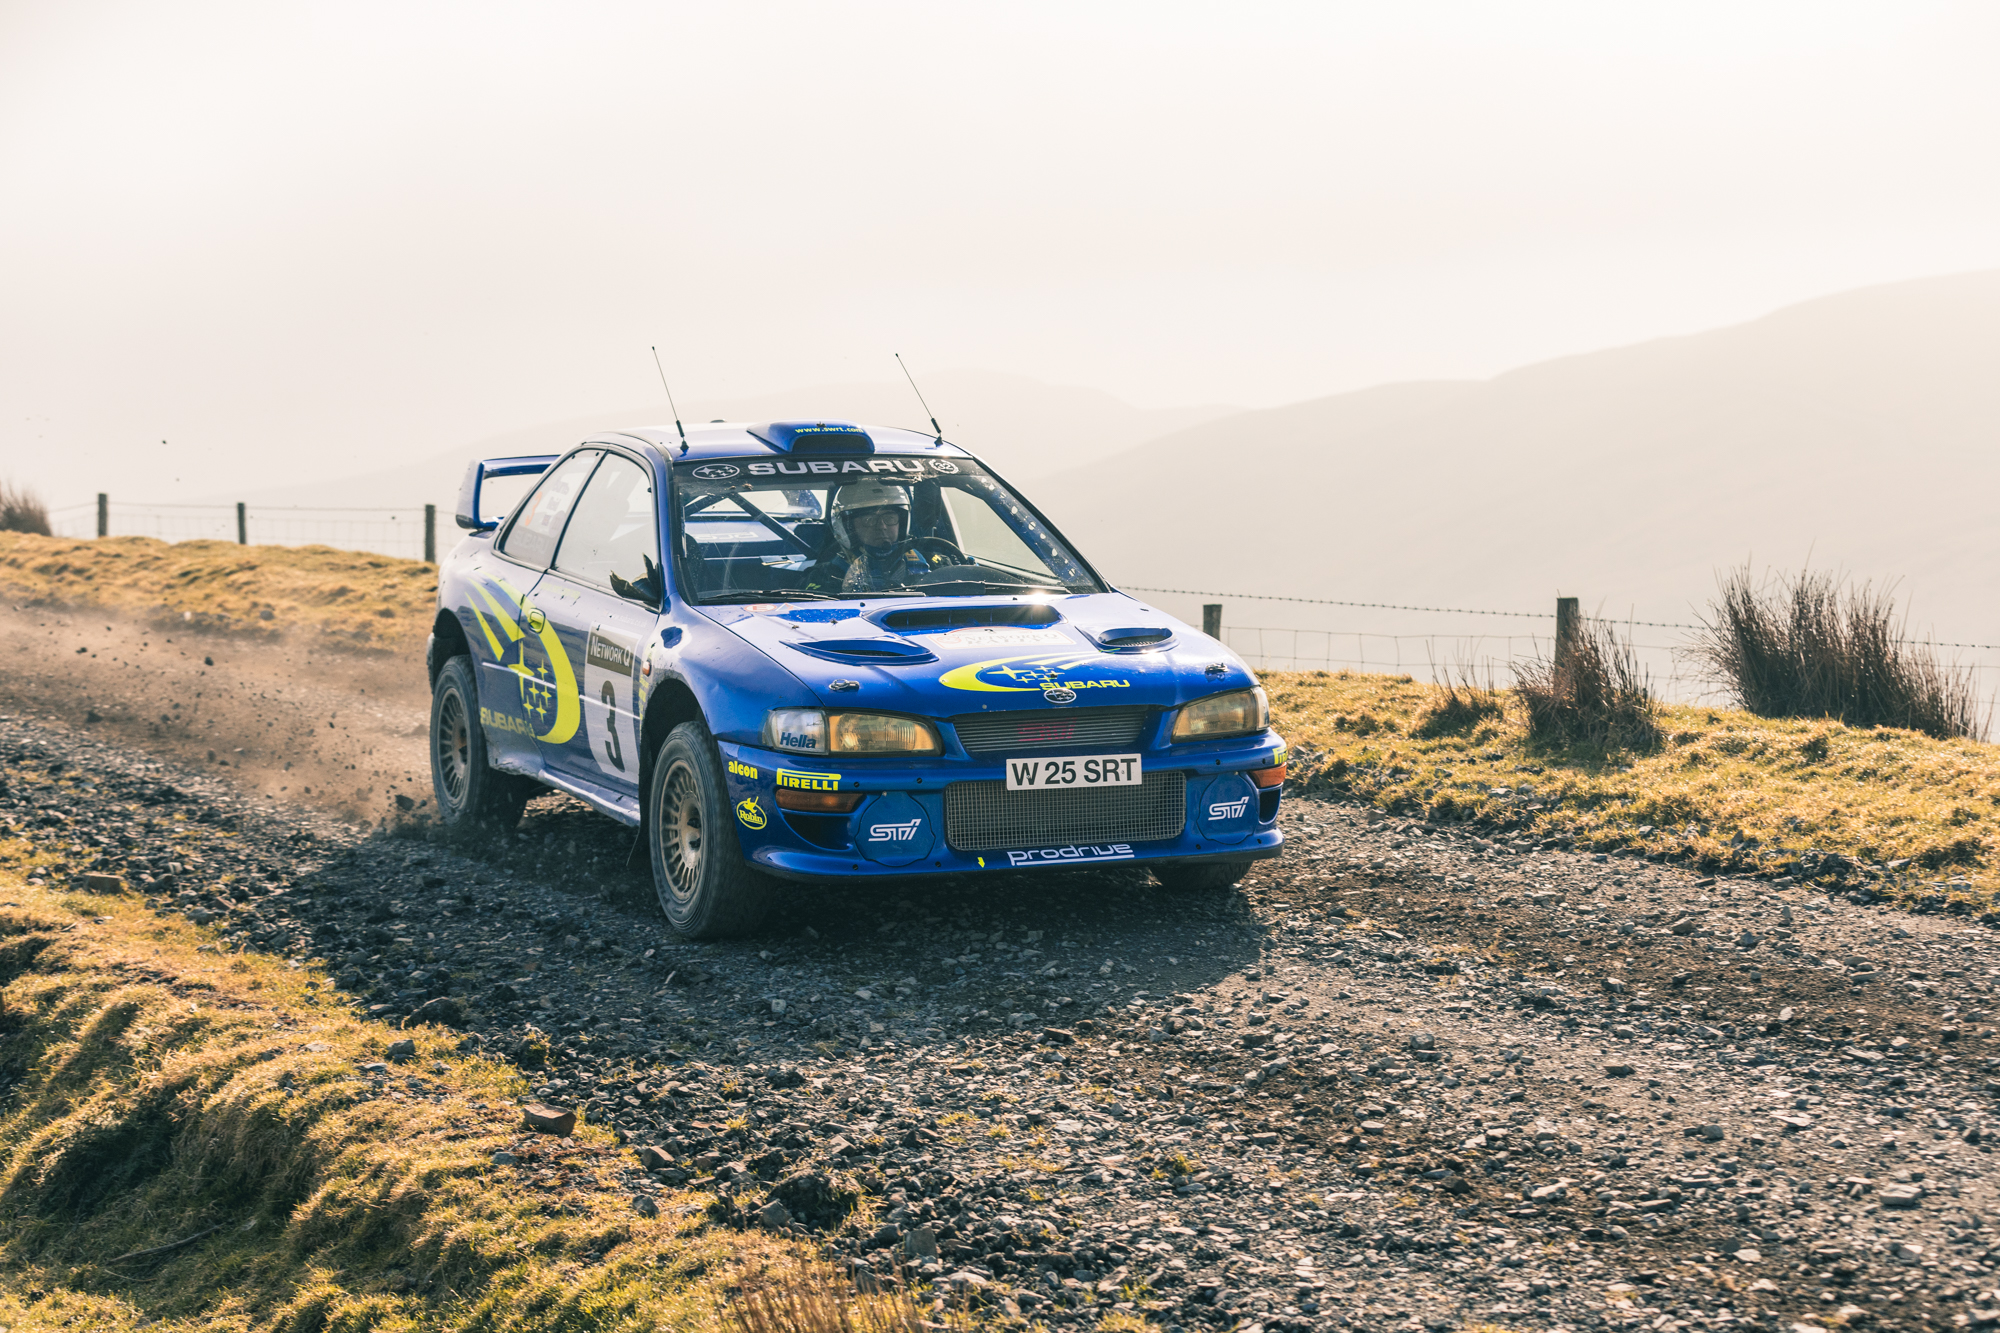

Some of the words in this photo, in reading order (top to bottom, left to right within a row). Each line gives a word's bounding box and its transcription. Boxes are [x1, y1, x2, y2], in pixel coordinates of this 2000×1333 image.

[748, 459, 925, 476] SUBARU
[591, 636, 623, 663] NETWORK
[623, 646, 631, 667] Q
[1039, 679, 1131, 690] SUBARU
[480, 707, 536, 738] SUBARU
[601, 680, 625, 773] 3
[780, 732, 817, 749] Hella
[728, 760, 758, 779] alcon
[776, 768, 842, 791] PIRELLI
[1011, 762, 1039, 786] W
[1045, 760, 1077, 785] 25
[1083, 758, 1137, 783] SRT
[739, 810, 764, 825] Robin
[1006, 843, 1135, 866] prodrive
